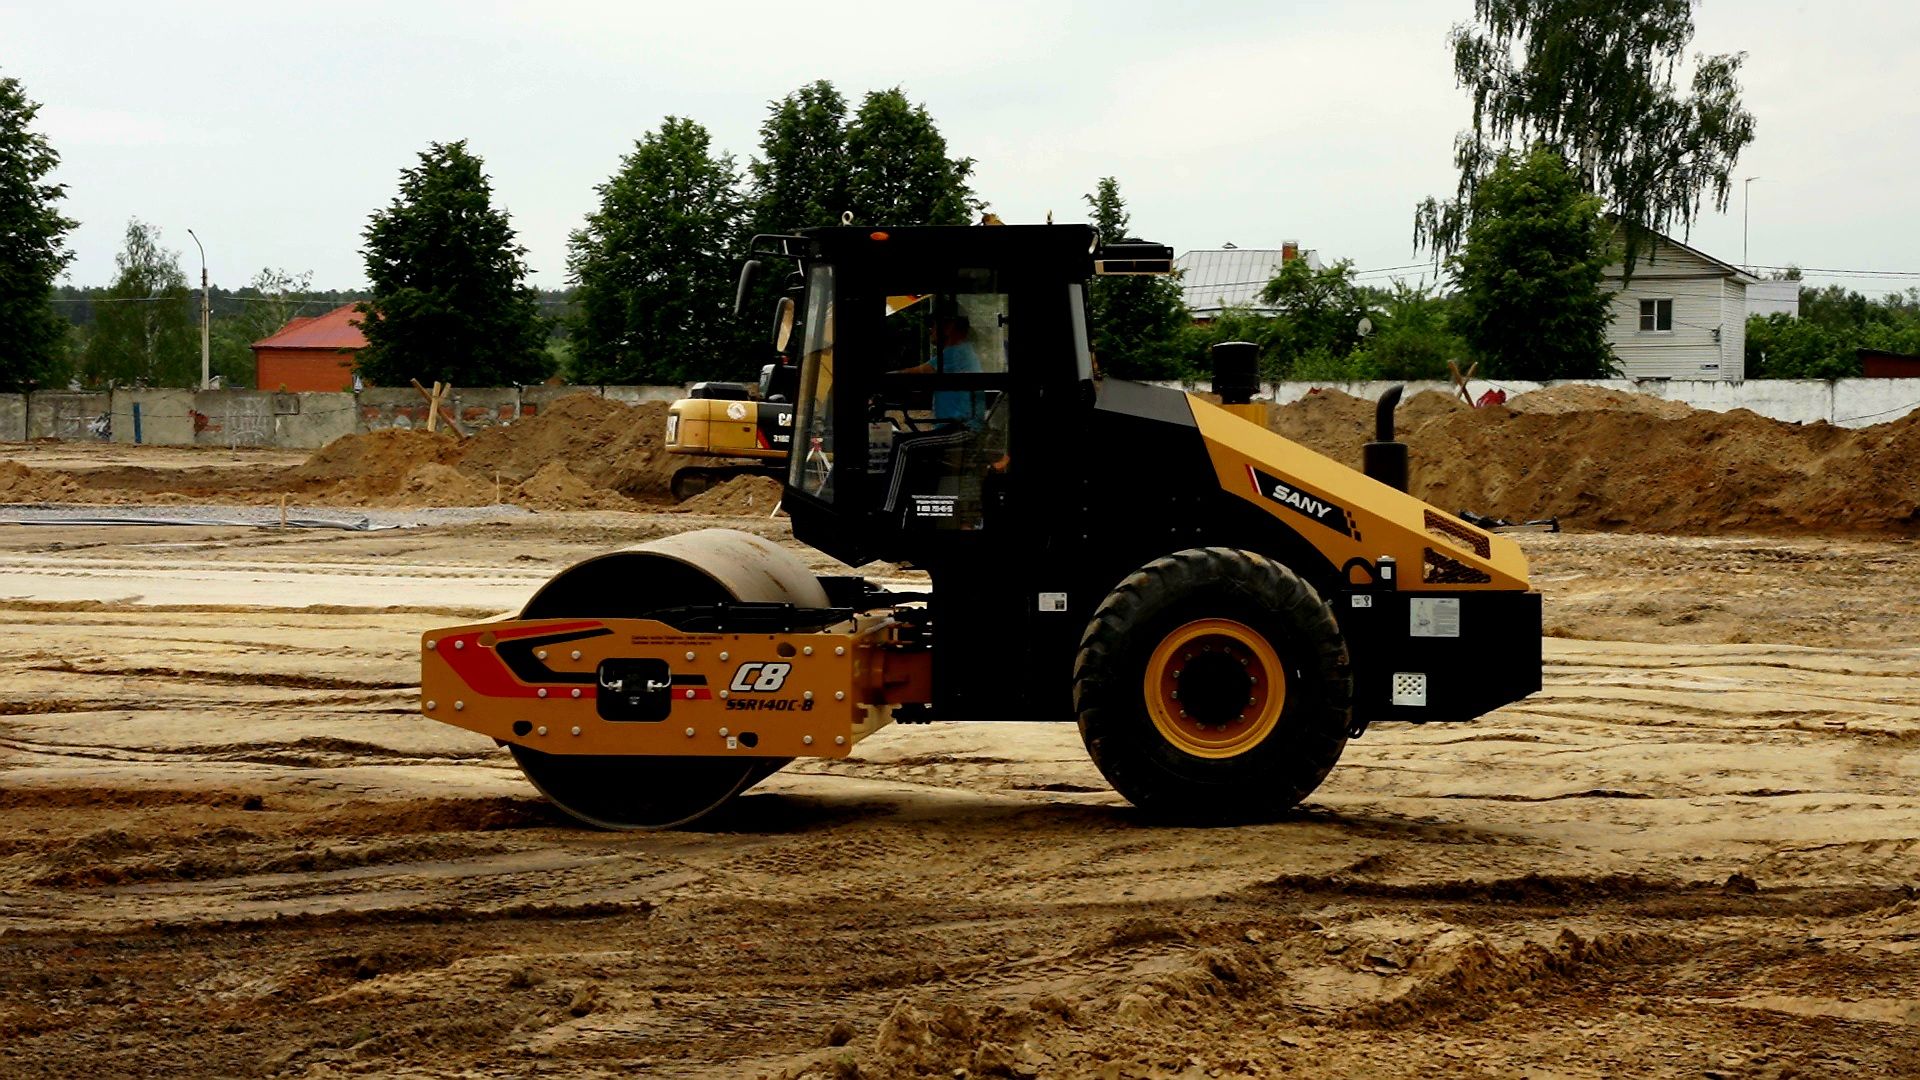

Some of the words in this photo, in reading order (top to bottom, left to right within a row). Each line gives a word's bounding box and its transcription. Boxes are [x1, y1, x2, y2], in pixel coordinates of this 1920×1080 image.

[779, 413, 792, 426] CA
[1272, 485, 1332, 518] SANY
[729, 661, 792, 692] C8
[726, 699, 814, 711] SSR140C-8
